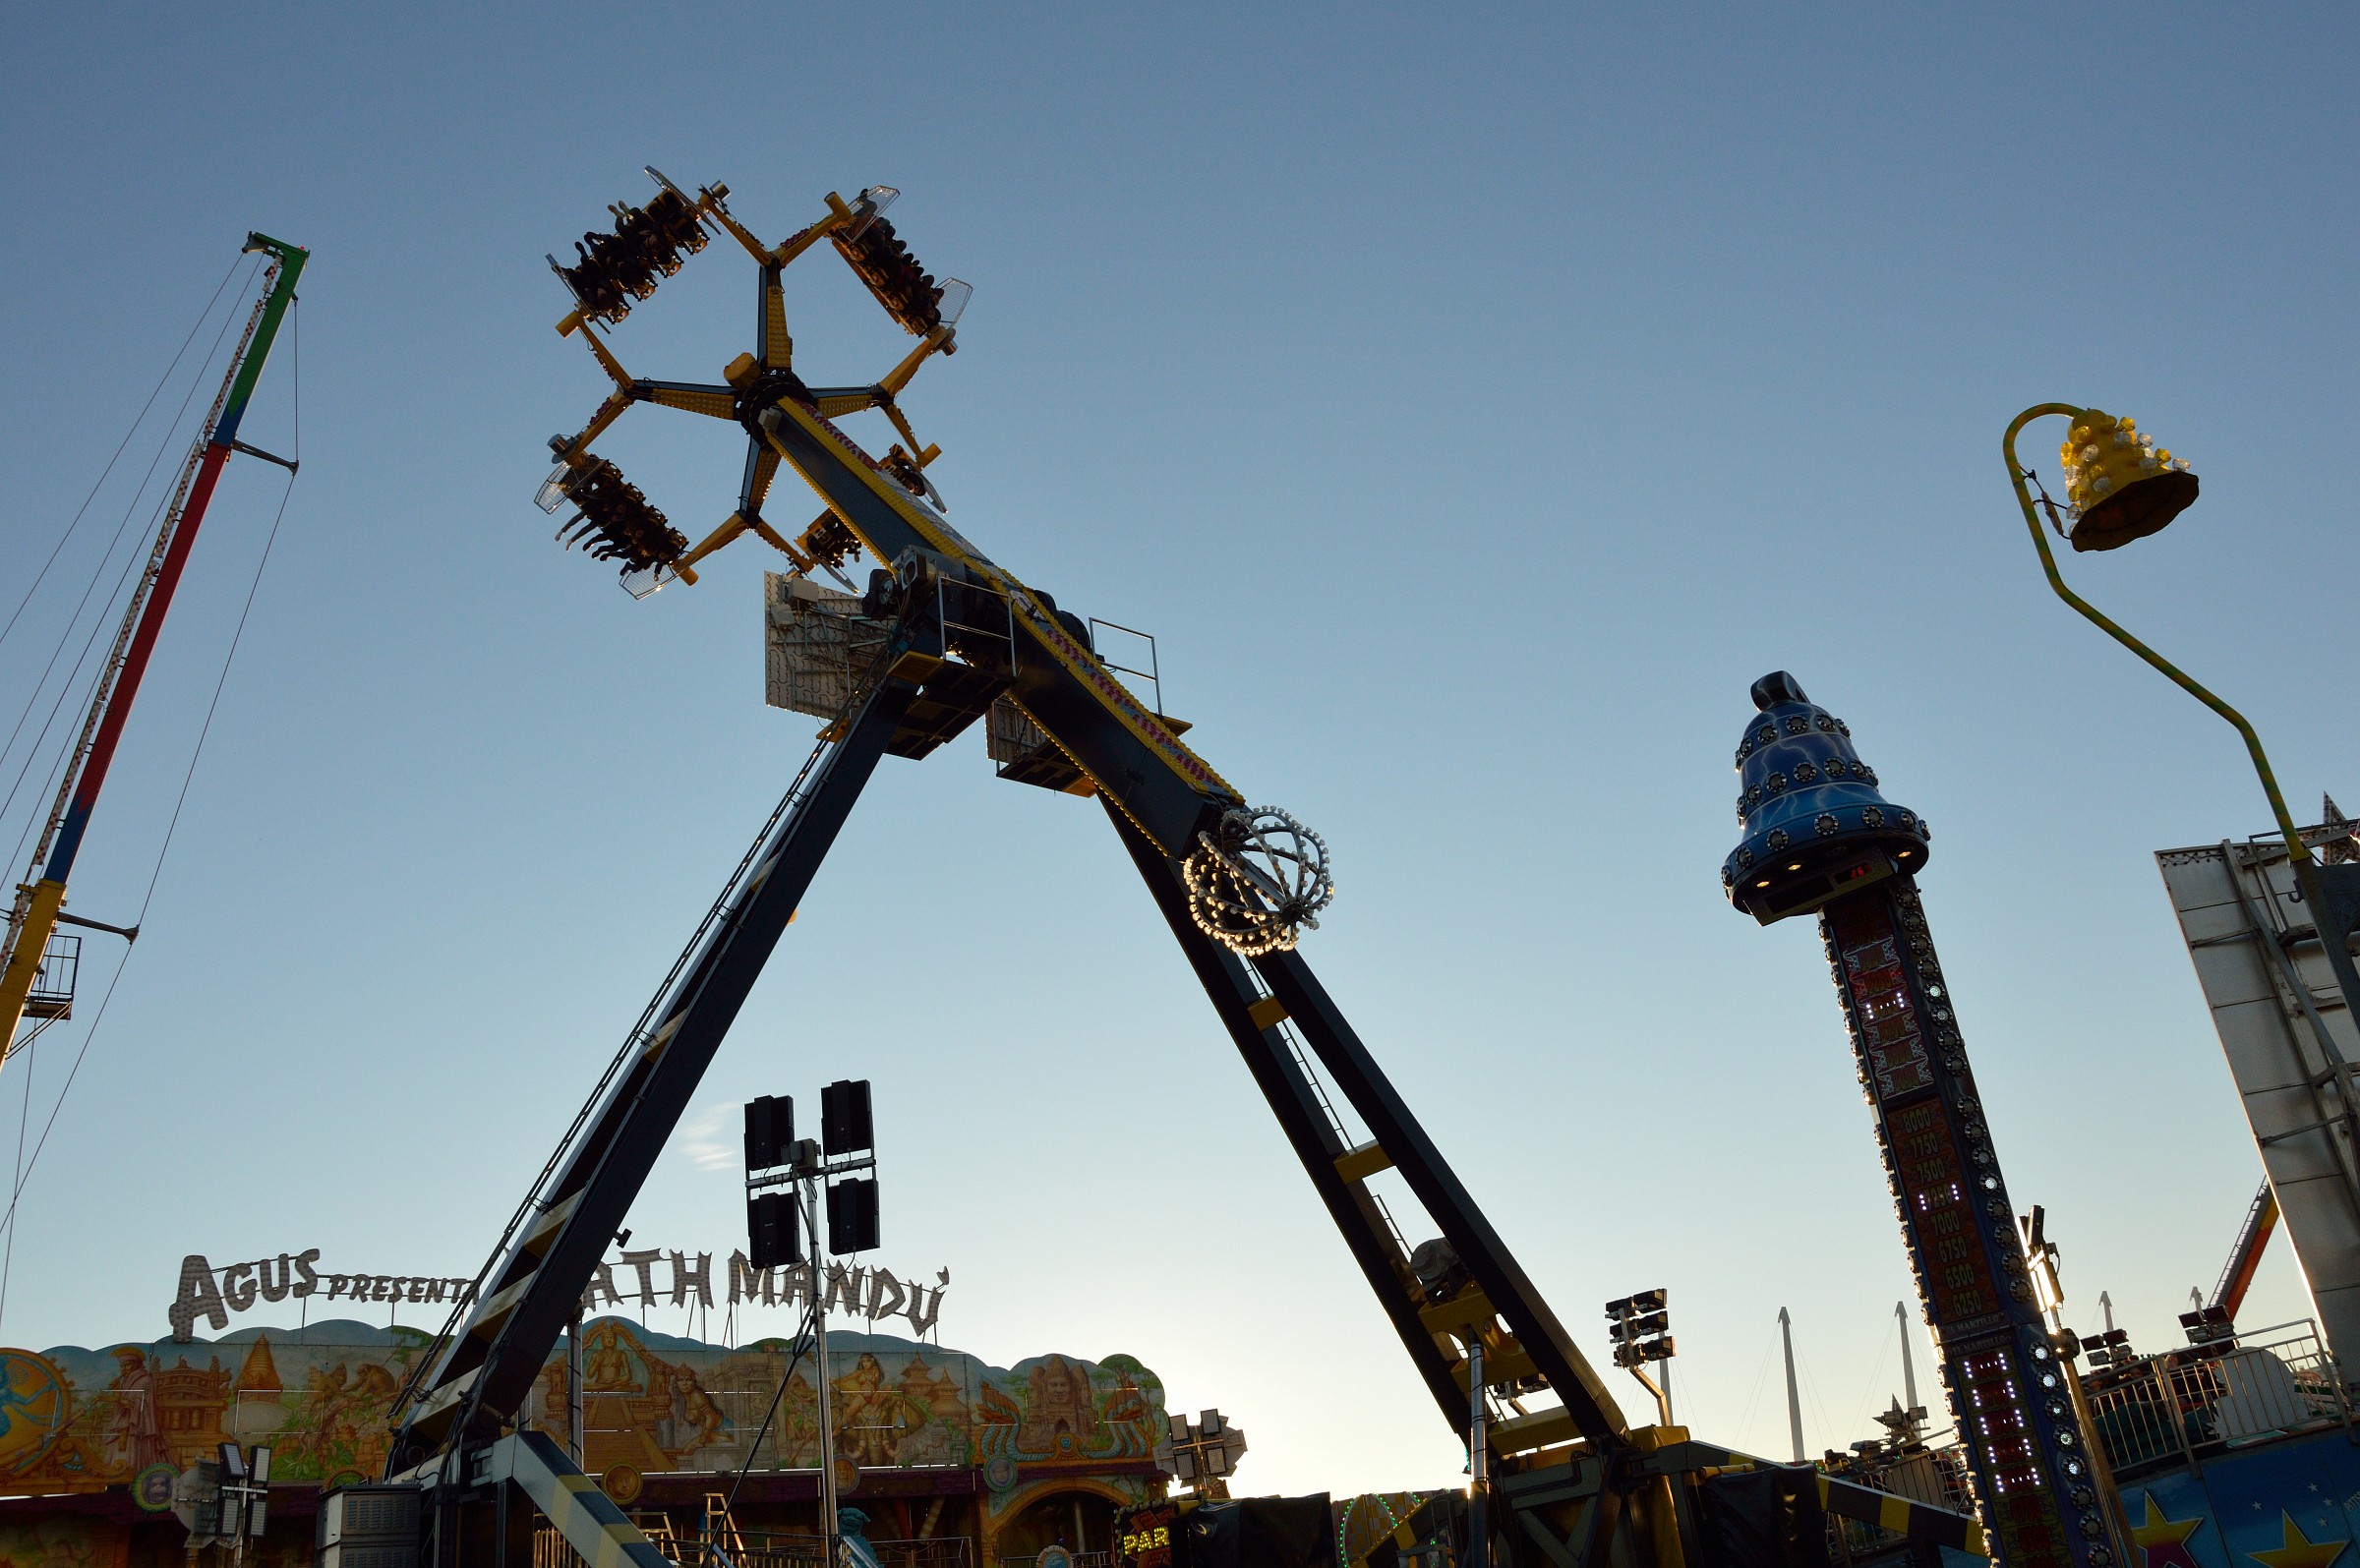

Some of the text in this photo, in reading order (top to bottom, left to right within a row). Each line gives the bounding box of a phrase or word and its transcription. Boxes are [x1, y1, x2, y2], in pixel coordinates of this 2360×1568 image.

[1902, 1105, 1931, 1134] 8000
[1910, 1131, 1938, 1159] 7750
[1917, 1156, 1946, 1186] 7500
[1923, 1182, 1953, 1211] 7250
[1930, 1208, 1960, 1238] 7000
[1938, 1235, 1968, 1263] 6750
[1945, 1261, 1975, 1291] 6500
[169, 1248, 321, 1344] AGUS
[1952, 1289, 1982, 1317] 6250
[1123, 1526, 1170, 1556] PAR
